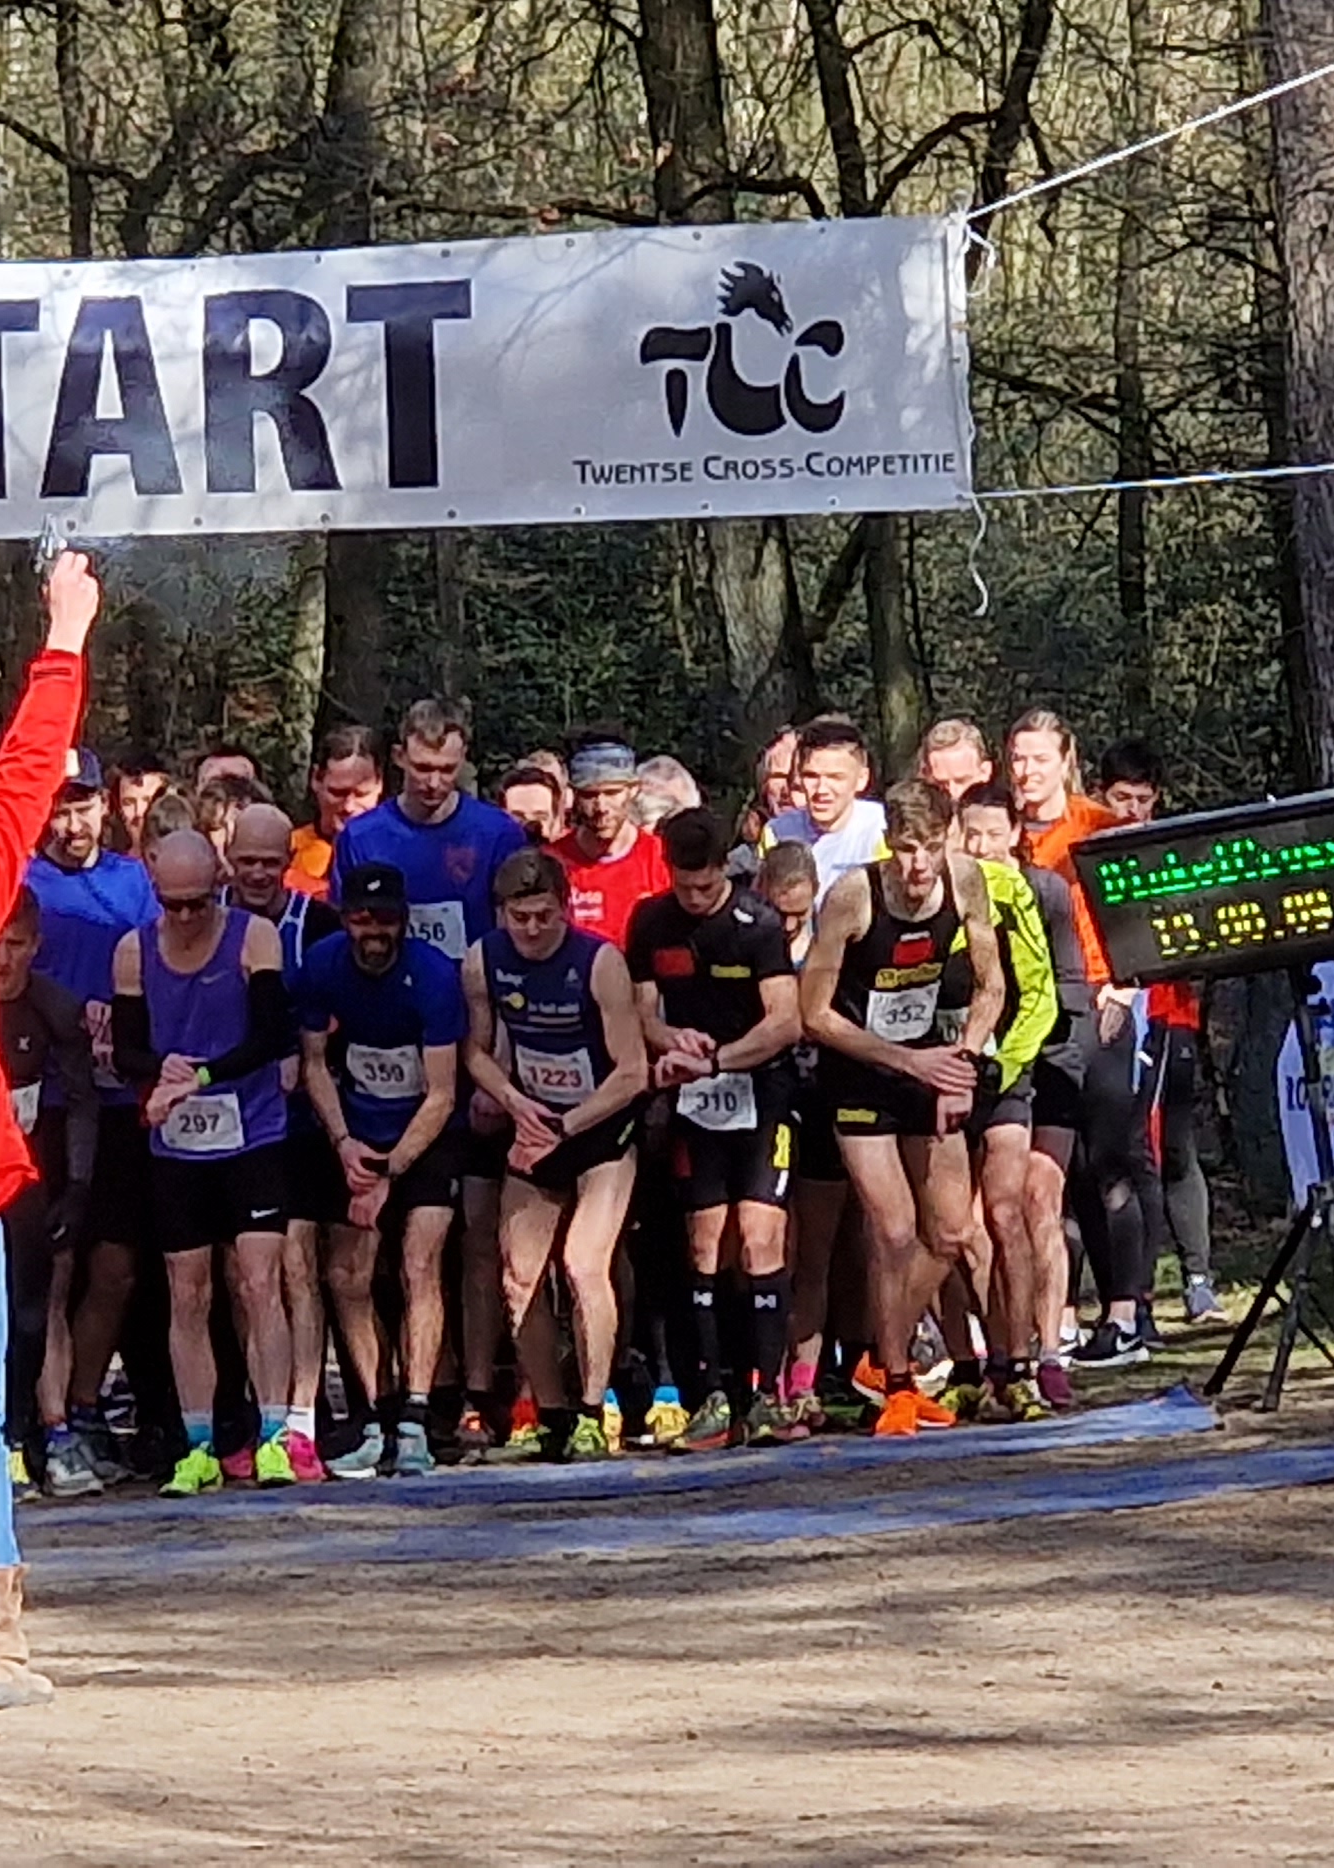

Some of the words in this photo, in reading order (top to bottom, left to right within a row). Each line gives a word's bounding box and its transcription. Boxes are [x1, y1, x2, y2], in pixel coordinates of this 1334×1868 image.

[884, 1003, 927, 1026] 352
[528, 1065, 583, 1088] 1223
[178, 1112, 221, 1135] 297
